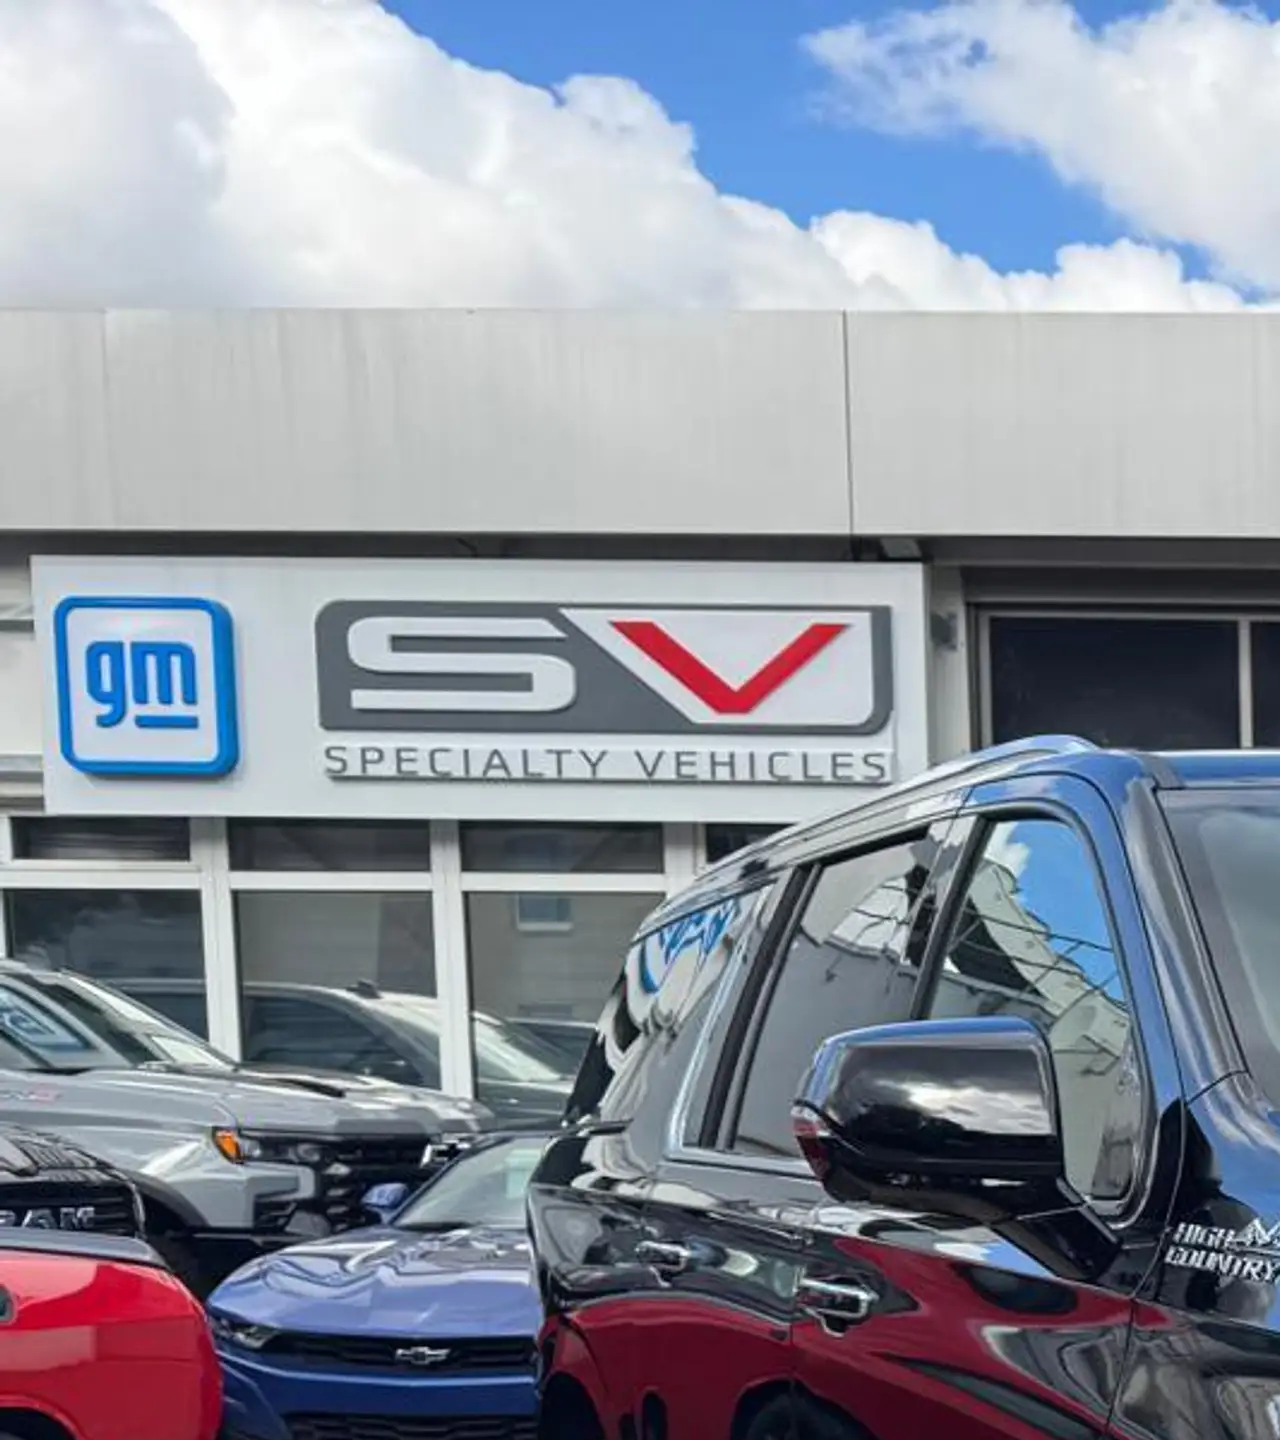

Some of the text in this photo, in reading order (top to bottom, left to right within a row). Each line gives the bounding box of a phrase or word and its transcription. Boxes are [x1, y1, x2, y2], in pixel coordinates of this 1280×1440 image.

[86, 640, 198, 729] gm
[347, 617, 853, 715] SV
[324, 745, 888, 782] SPECIALTY VEHICLES
[1172, 1221, 1237, 1249] HIGH
